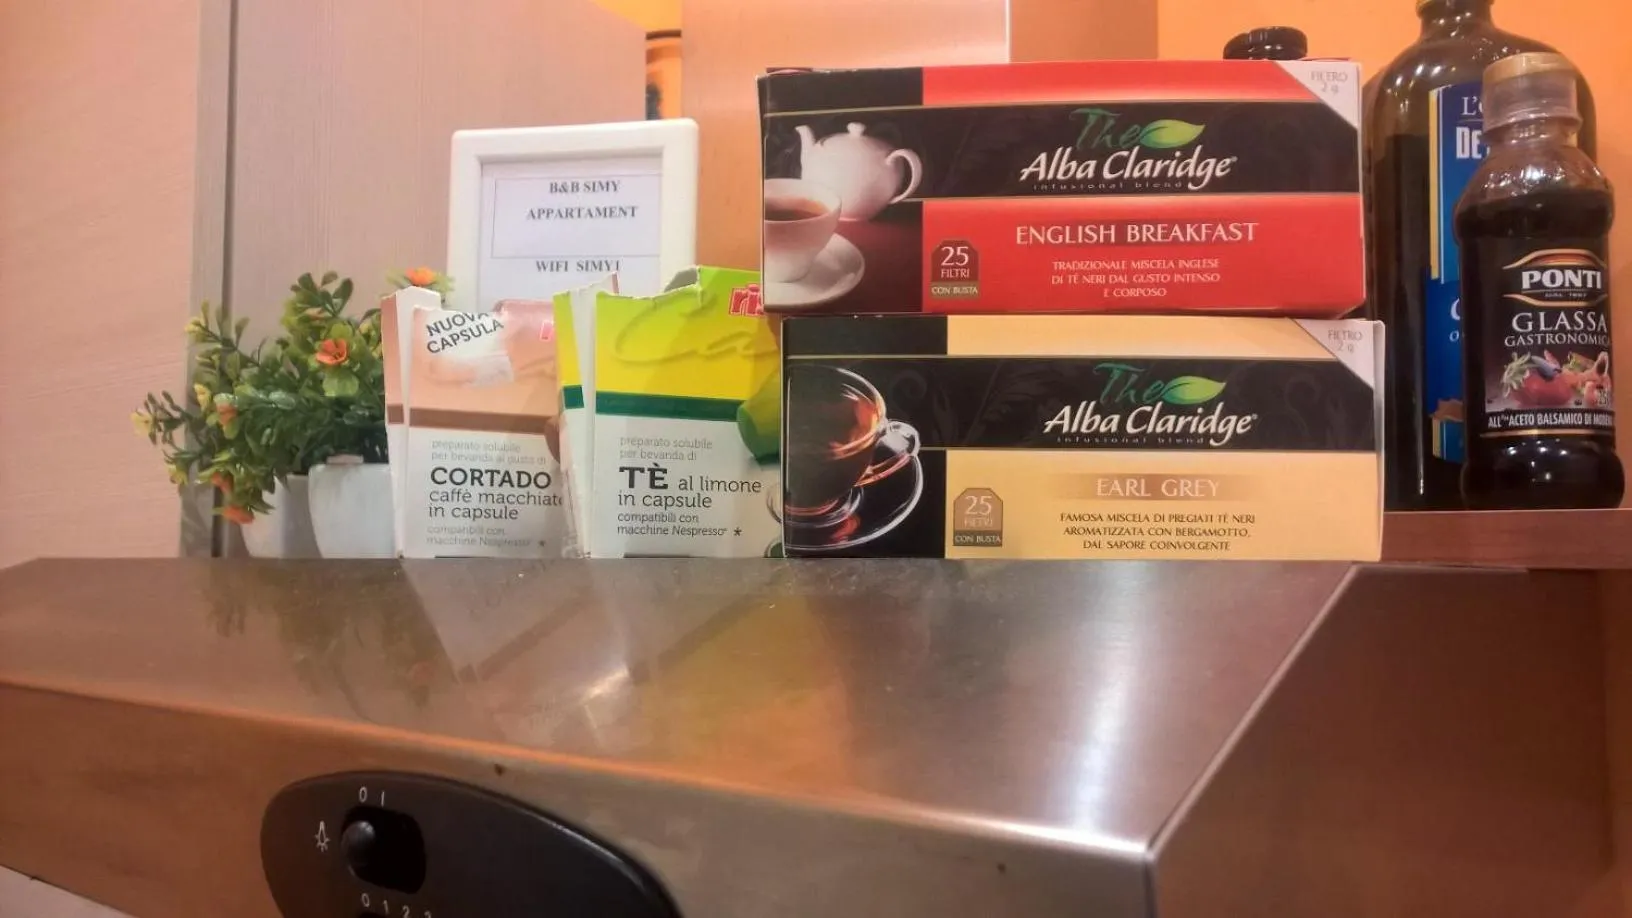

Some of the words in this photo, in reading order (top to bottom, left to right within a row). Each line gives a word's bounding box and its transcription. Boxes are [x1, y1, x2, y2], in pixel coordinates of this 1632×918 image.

[1019, 146, 1097, 181] Alba
[549, 181, 580, 194] B&B
[583, 180, 621, 193] SIMY
[526, 205, 639, 221] APPARTAMENT
[1016, 224, 1116, 245] ENGLISH
[1127, 222, 1259, 243] BREAKFAST
[941, 246, 969, 266] 25
[536, 260, 569, 272] WIFI
[1053, 260, 1127, 271] TRADIZIONALE
[1131, 259, 1175, 271] MISCELA
[1178, 258, 1220, 269] INGLESE
[941, 268, 970, 278] FILTRI
[1051, 275, 1064, 285] DI
[1083, 274, 1106, 285] NERI
[1109, 274, 1128, 284] DAL
[1132, 273, 1170, 284] GUSTO
[1174, 272, 1221, 283] INTENSO
[1521, 269, 1602, 290] PONTI
[931, 286, 951, 295] CON
[953, 286, 978, 294] BUSTA
[1113, 287, 1167, 298] CORPOSO
[1512, 310, 1608, 334] GLASSA
[426, 318, 505, 355] CAPSULA
[1043, 401, 1121, 434] Alba
[1537, 412, 1583, 425] BALSAMICO
[619, 438, 670, 449] preparato
[673, 438, 713, 449] solubile
[619, 451, 637, 460] per
[640, 448, 684, 460] bevanda
[687, 450, 697, 460] di
[430, 467, 552, 489] CORTADO
[619, 462, 668, 489] TÈ
[678, 475, 694, 491] al
[700, 476, 762, 493] limone
[1096, 479, 1151, 496] EARL
[1161, 478, 1220, 496] GREY
[429, 489, 472, 503] caffè
[618, 491, 635, 506] in
[642, 492, 712, 511] capsule
[964, 495, 992, 515] 25
[429, 504, 445, 517] in
[451, 506, 518, 521] capsule
[617, 511, 676, 524] compatibili
[679, 514, 699, 523] con
[1060, 513, 1103, 523] FAMOSA
[1106, 513, 1150, 523] MISCELA
[1153, 513, 1165, 523] DI
[1168, 513, 1213, 523] PREGIATI
[1232, 514, 1256, 524] NERI
[617, 524, 669, 536] macchine
[1063, 527, 1145, 537] AROMATIZZATA
[1147, 527, 1172, 537] CON
[954, 535, 974, 544] CON
[976, 535, 1001, 544] BUSTA
[1082, 541, 1101, 550] DAL
[1106, 540, 1146, 550] SAPORE
[1149, 541, 1231, 552] COINVOLGENTE
